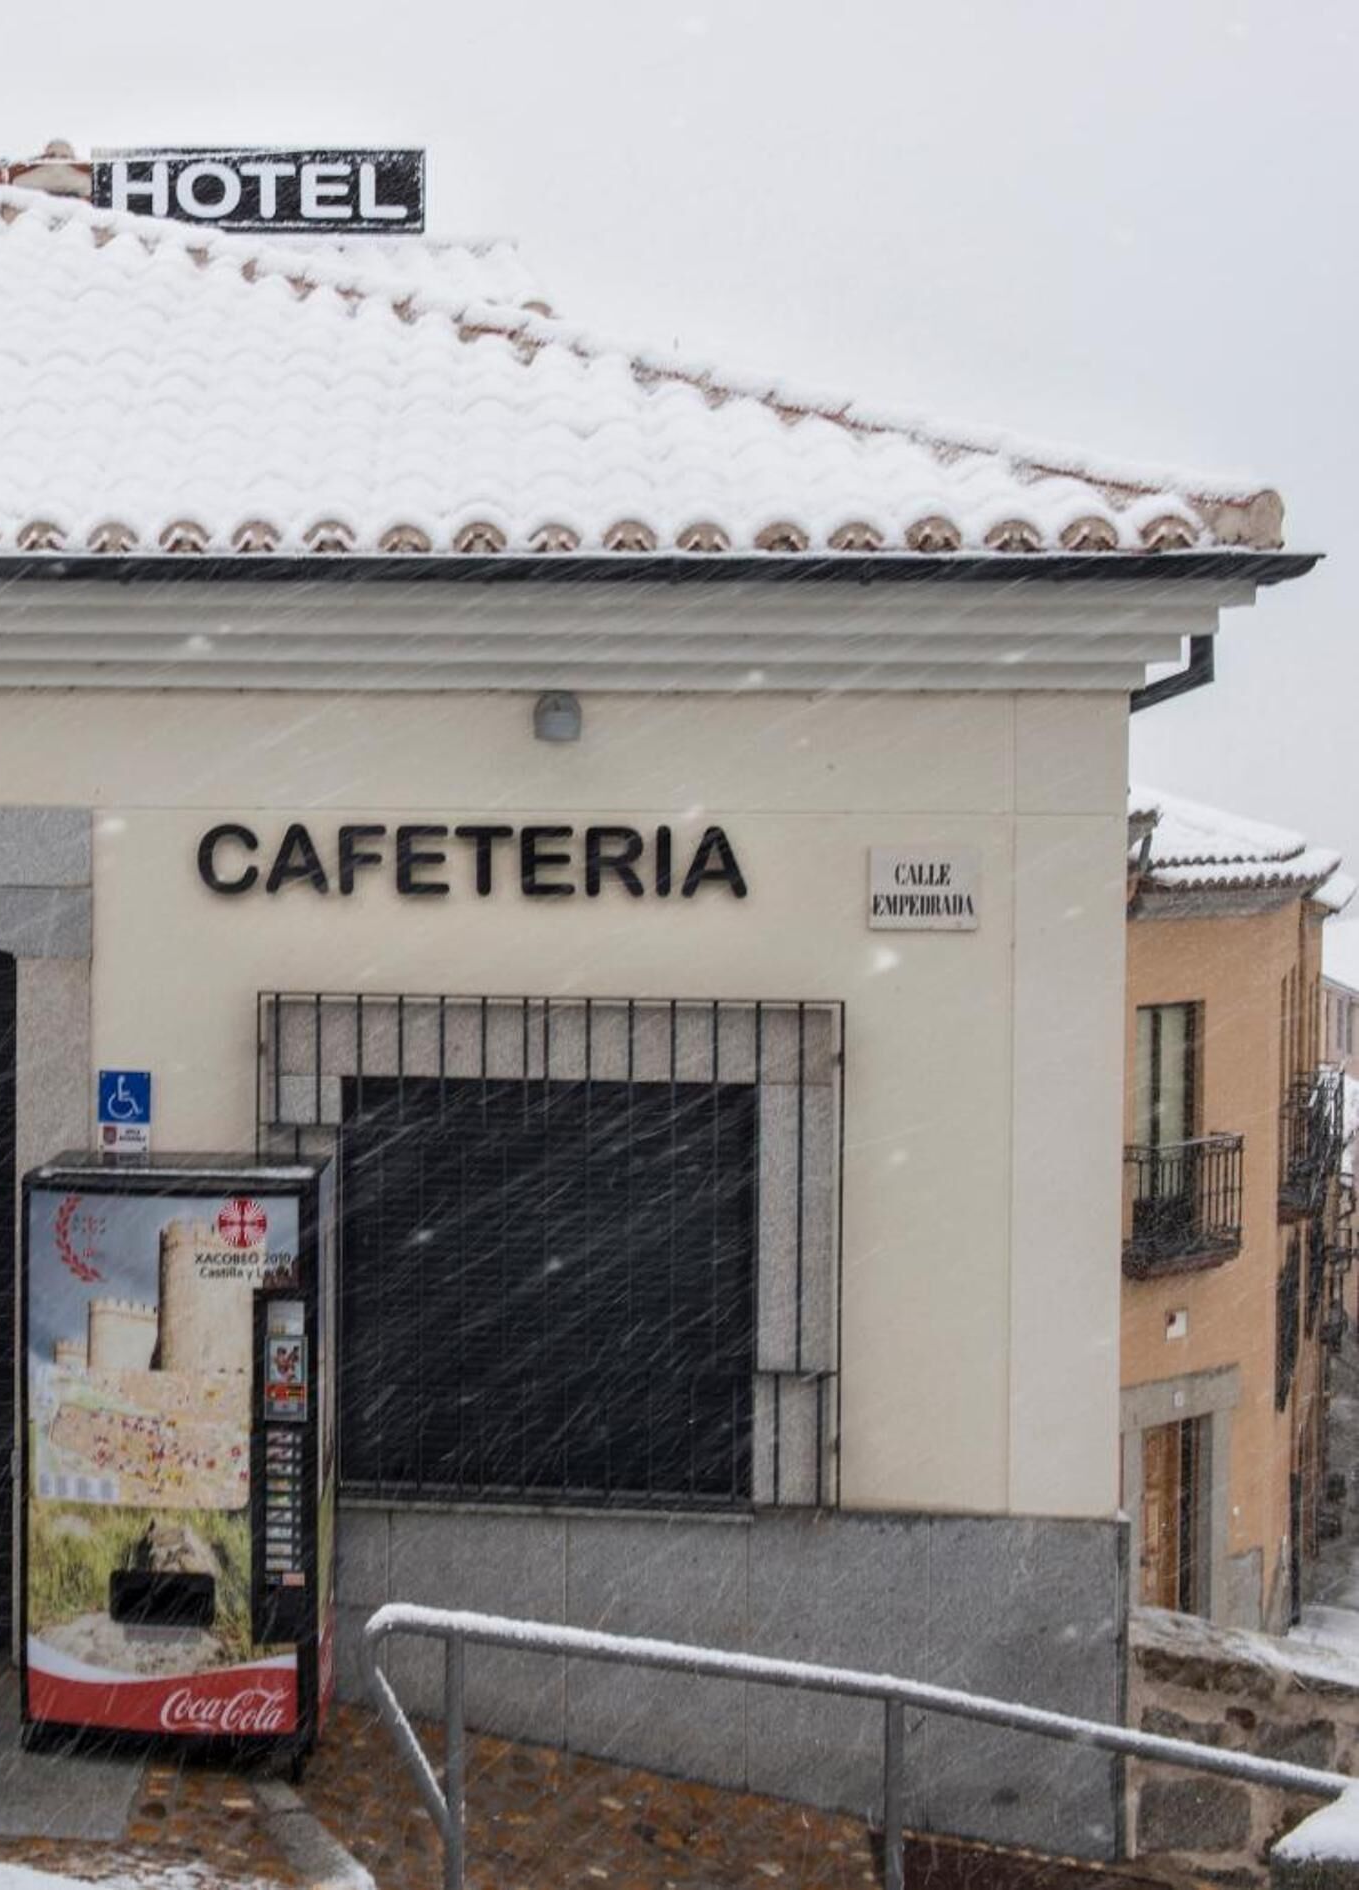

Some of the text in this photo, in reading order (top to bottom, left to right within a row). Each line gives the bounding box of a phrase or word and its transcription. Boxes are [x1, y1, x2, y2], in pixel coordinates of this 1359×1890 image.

[111, 162, 408, 219] HOTEL
[196, 823, 747, 898] CAFETERIA
[894, 863, 951, 886] CALLE
[872, 893, 974, 916] EMPEDRADA
[194, 1251, 291, 1266] XACOBEO 2010
[199, 1266, 244, 1279] Castilla
